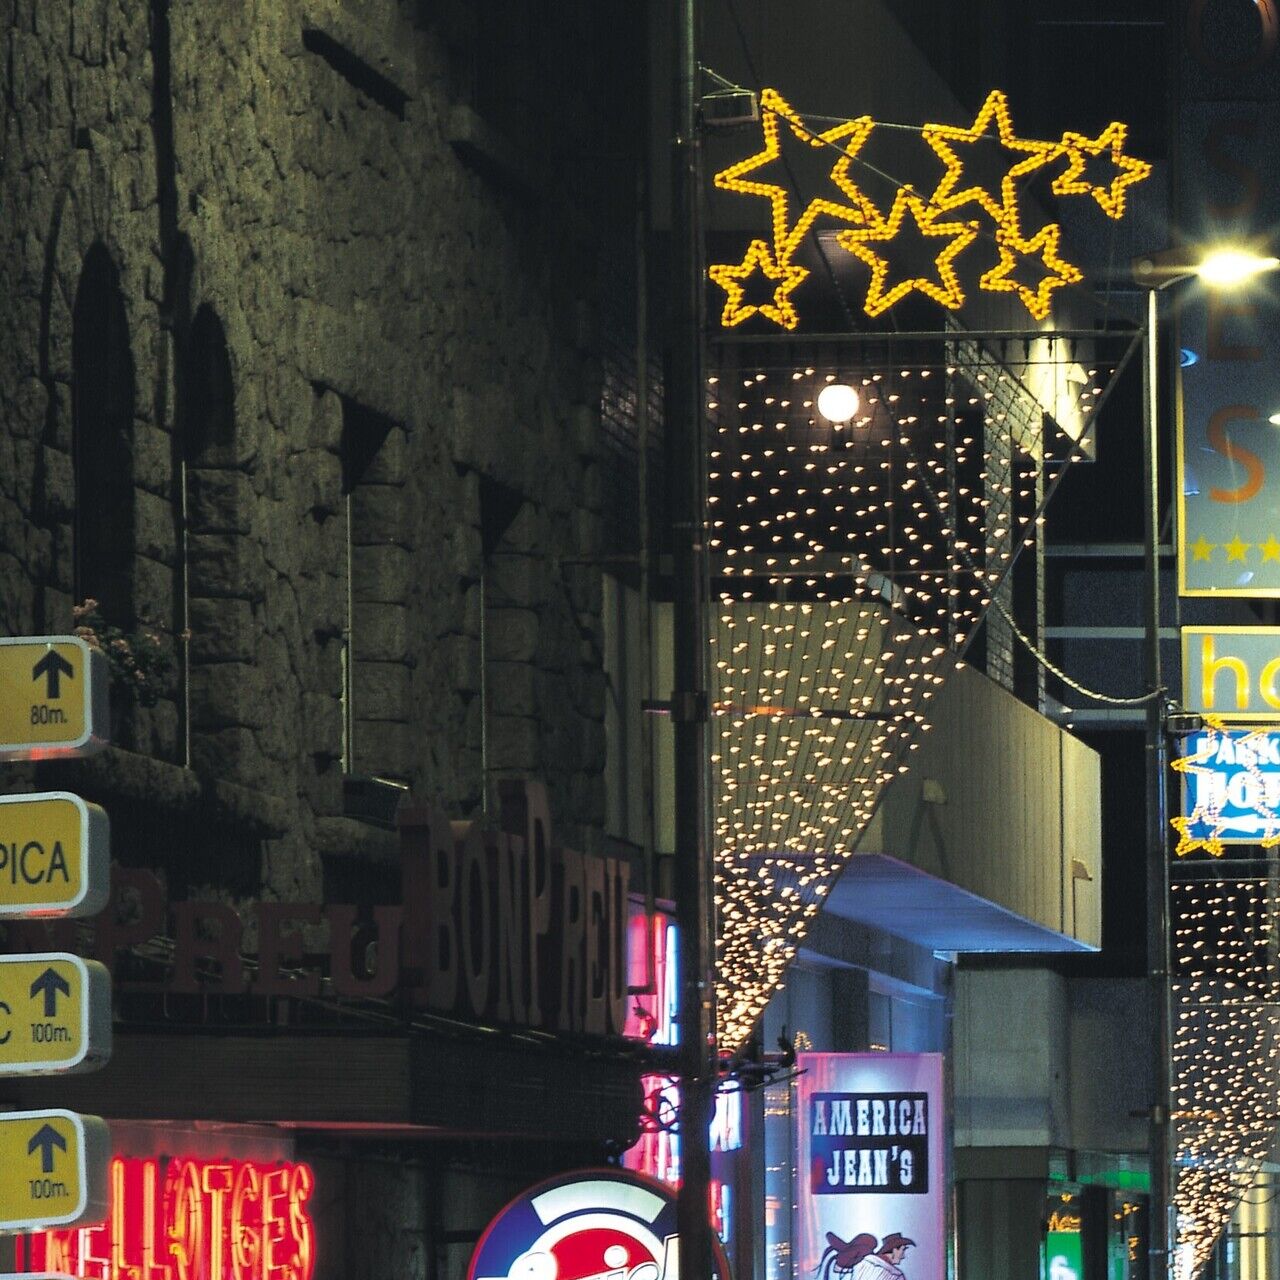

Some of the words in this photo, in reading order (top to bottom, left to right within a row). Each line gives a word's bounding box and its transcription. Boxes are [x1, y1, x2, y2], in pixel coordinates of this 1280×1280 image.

[30, 704, 69, 726] 80m.
[31, 1023, 72, 1044] 100m.
[813, 1097, 928, 1137] AMERICA
[826, 1146, 913, 1187] JEAN'S
[28, 1179, 70, 1199] 100m.
